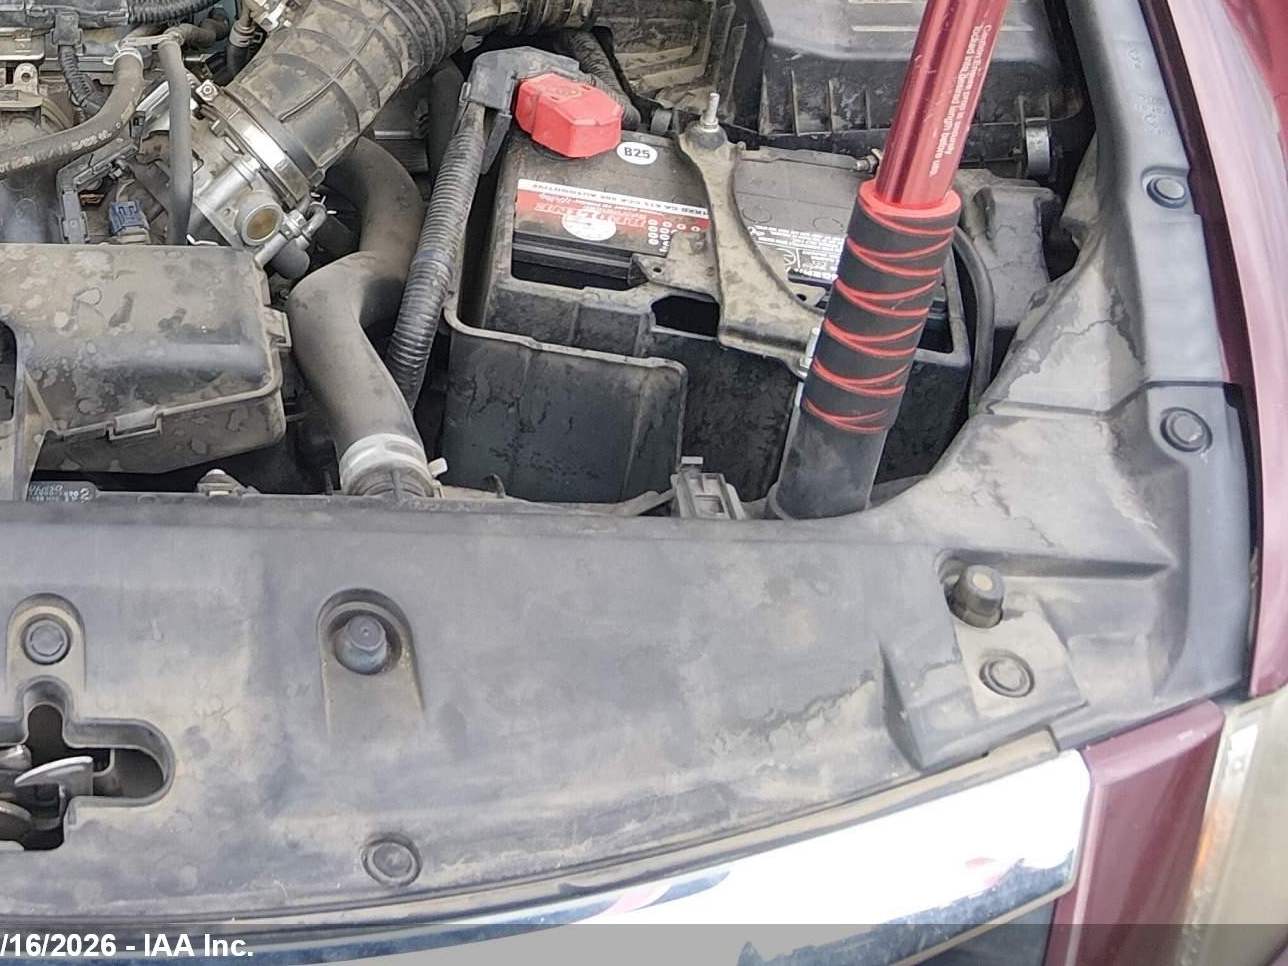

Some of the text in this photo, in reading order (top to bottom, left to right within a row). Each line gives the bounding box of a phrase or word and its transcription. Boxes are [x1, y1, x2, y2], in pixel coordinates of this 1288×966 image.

[943, 105, 961, 131] length
[935, 132, 951, 159] before
[943, 120, 961, 155] securely
[624, 146, 650, 159] B25
